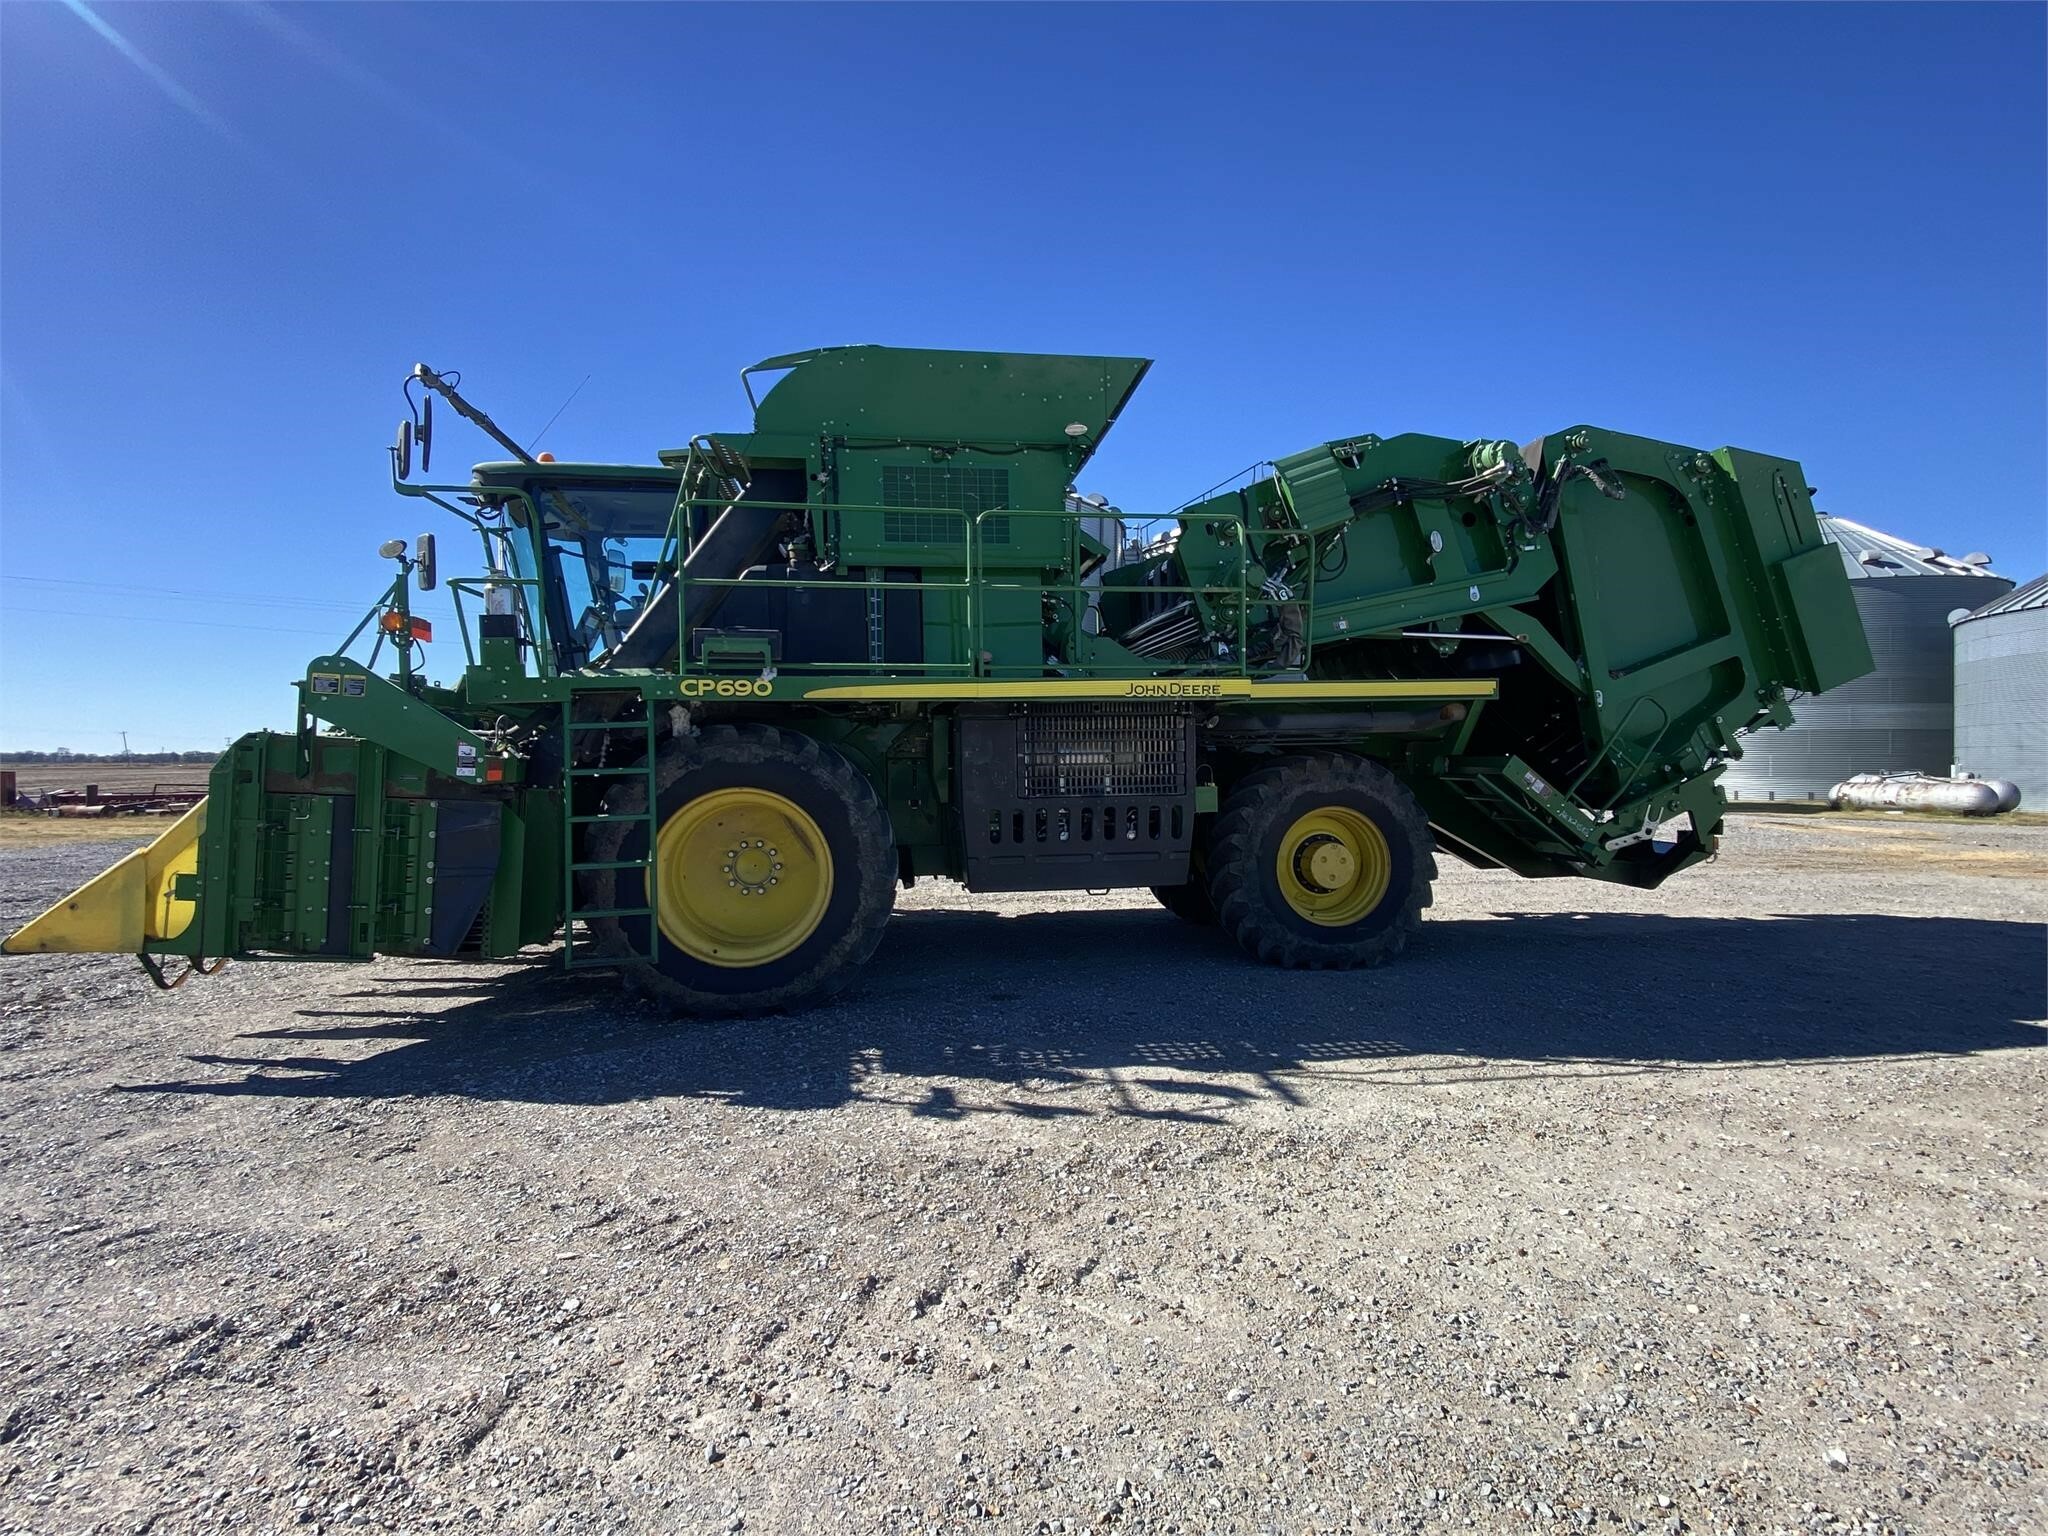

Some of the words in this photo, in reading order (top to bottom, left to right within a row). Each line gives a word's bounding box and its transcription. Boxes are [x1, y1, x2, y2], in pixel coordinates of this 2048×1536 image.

[680, 679, 773, 696] CP690
[1125, 682, 1167, 696] JOHN
[1169, 682, 1222, 695] DEERE
